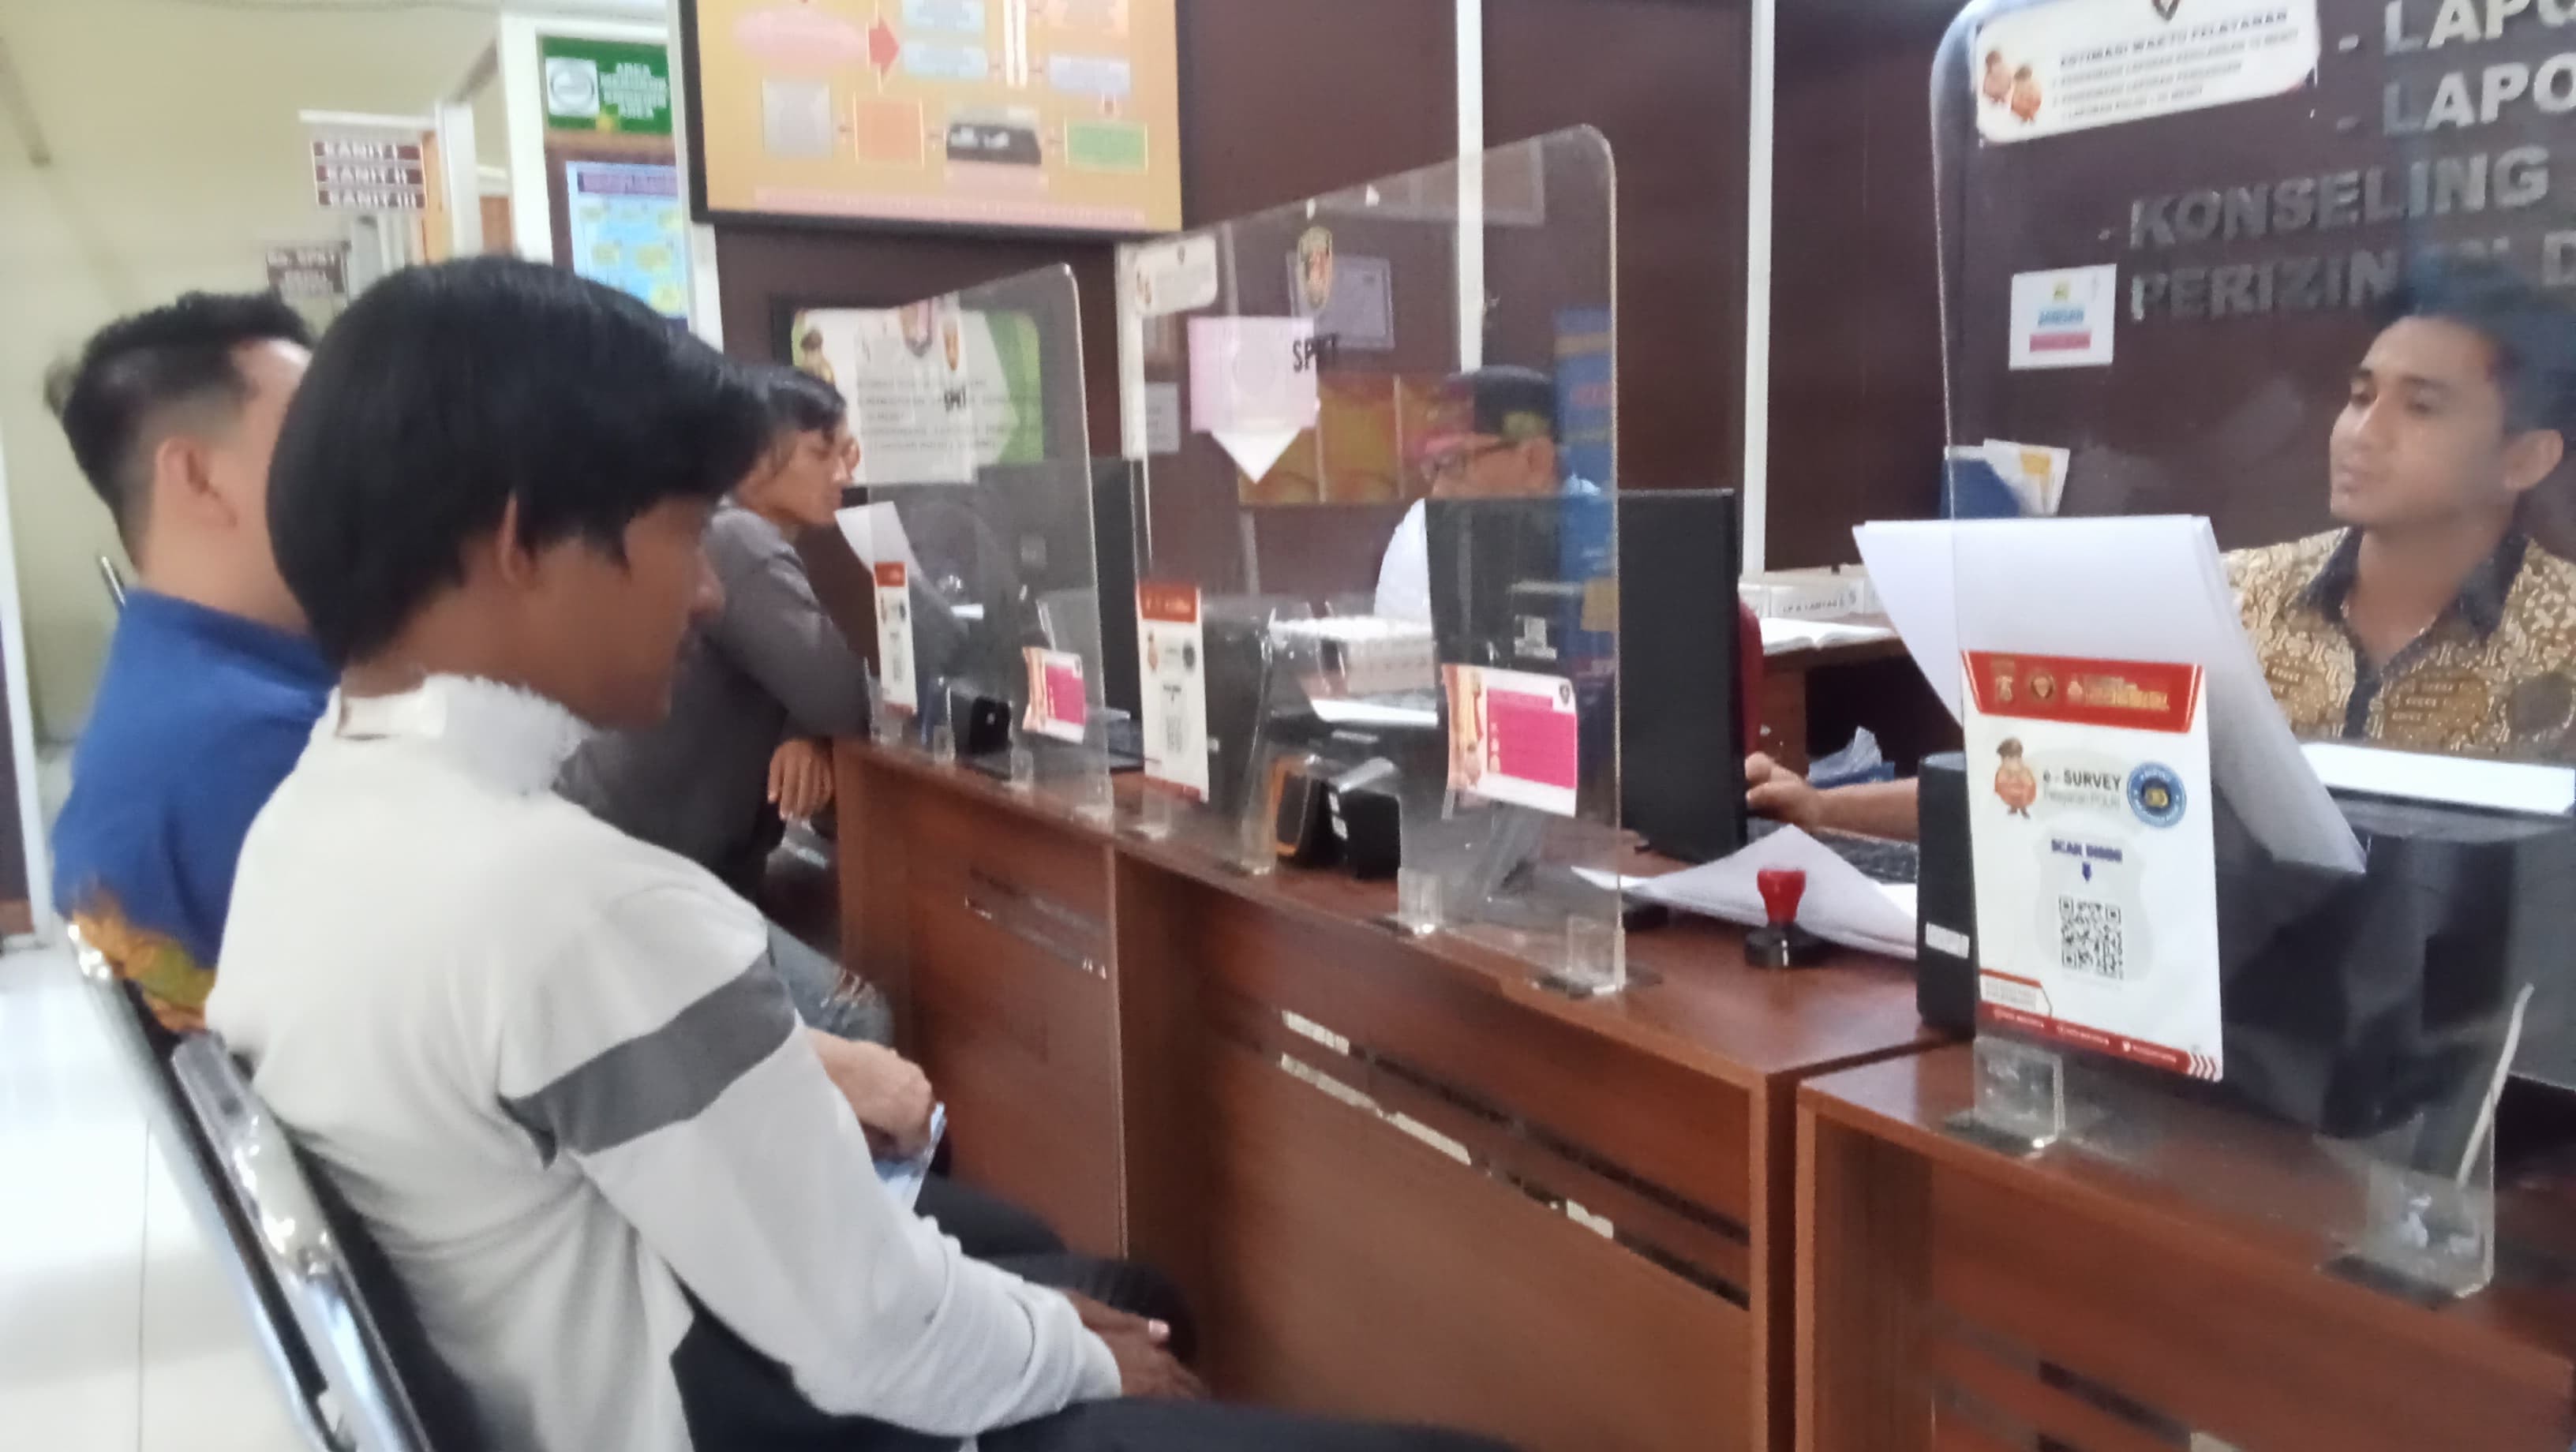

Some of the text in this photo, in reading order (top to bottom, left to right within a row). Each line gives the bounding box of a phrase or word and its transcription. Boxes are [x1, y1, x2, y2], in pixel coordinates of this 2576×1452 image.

[2130, 147, 2550, 249] KONSELING
[2132, 235, 2511, 320] PERIZIN
[2064, 768, 2122, 792] SURVEY
